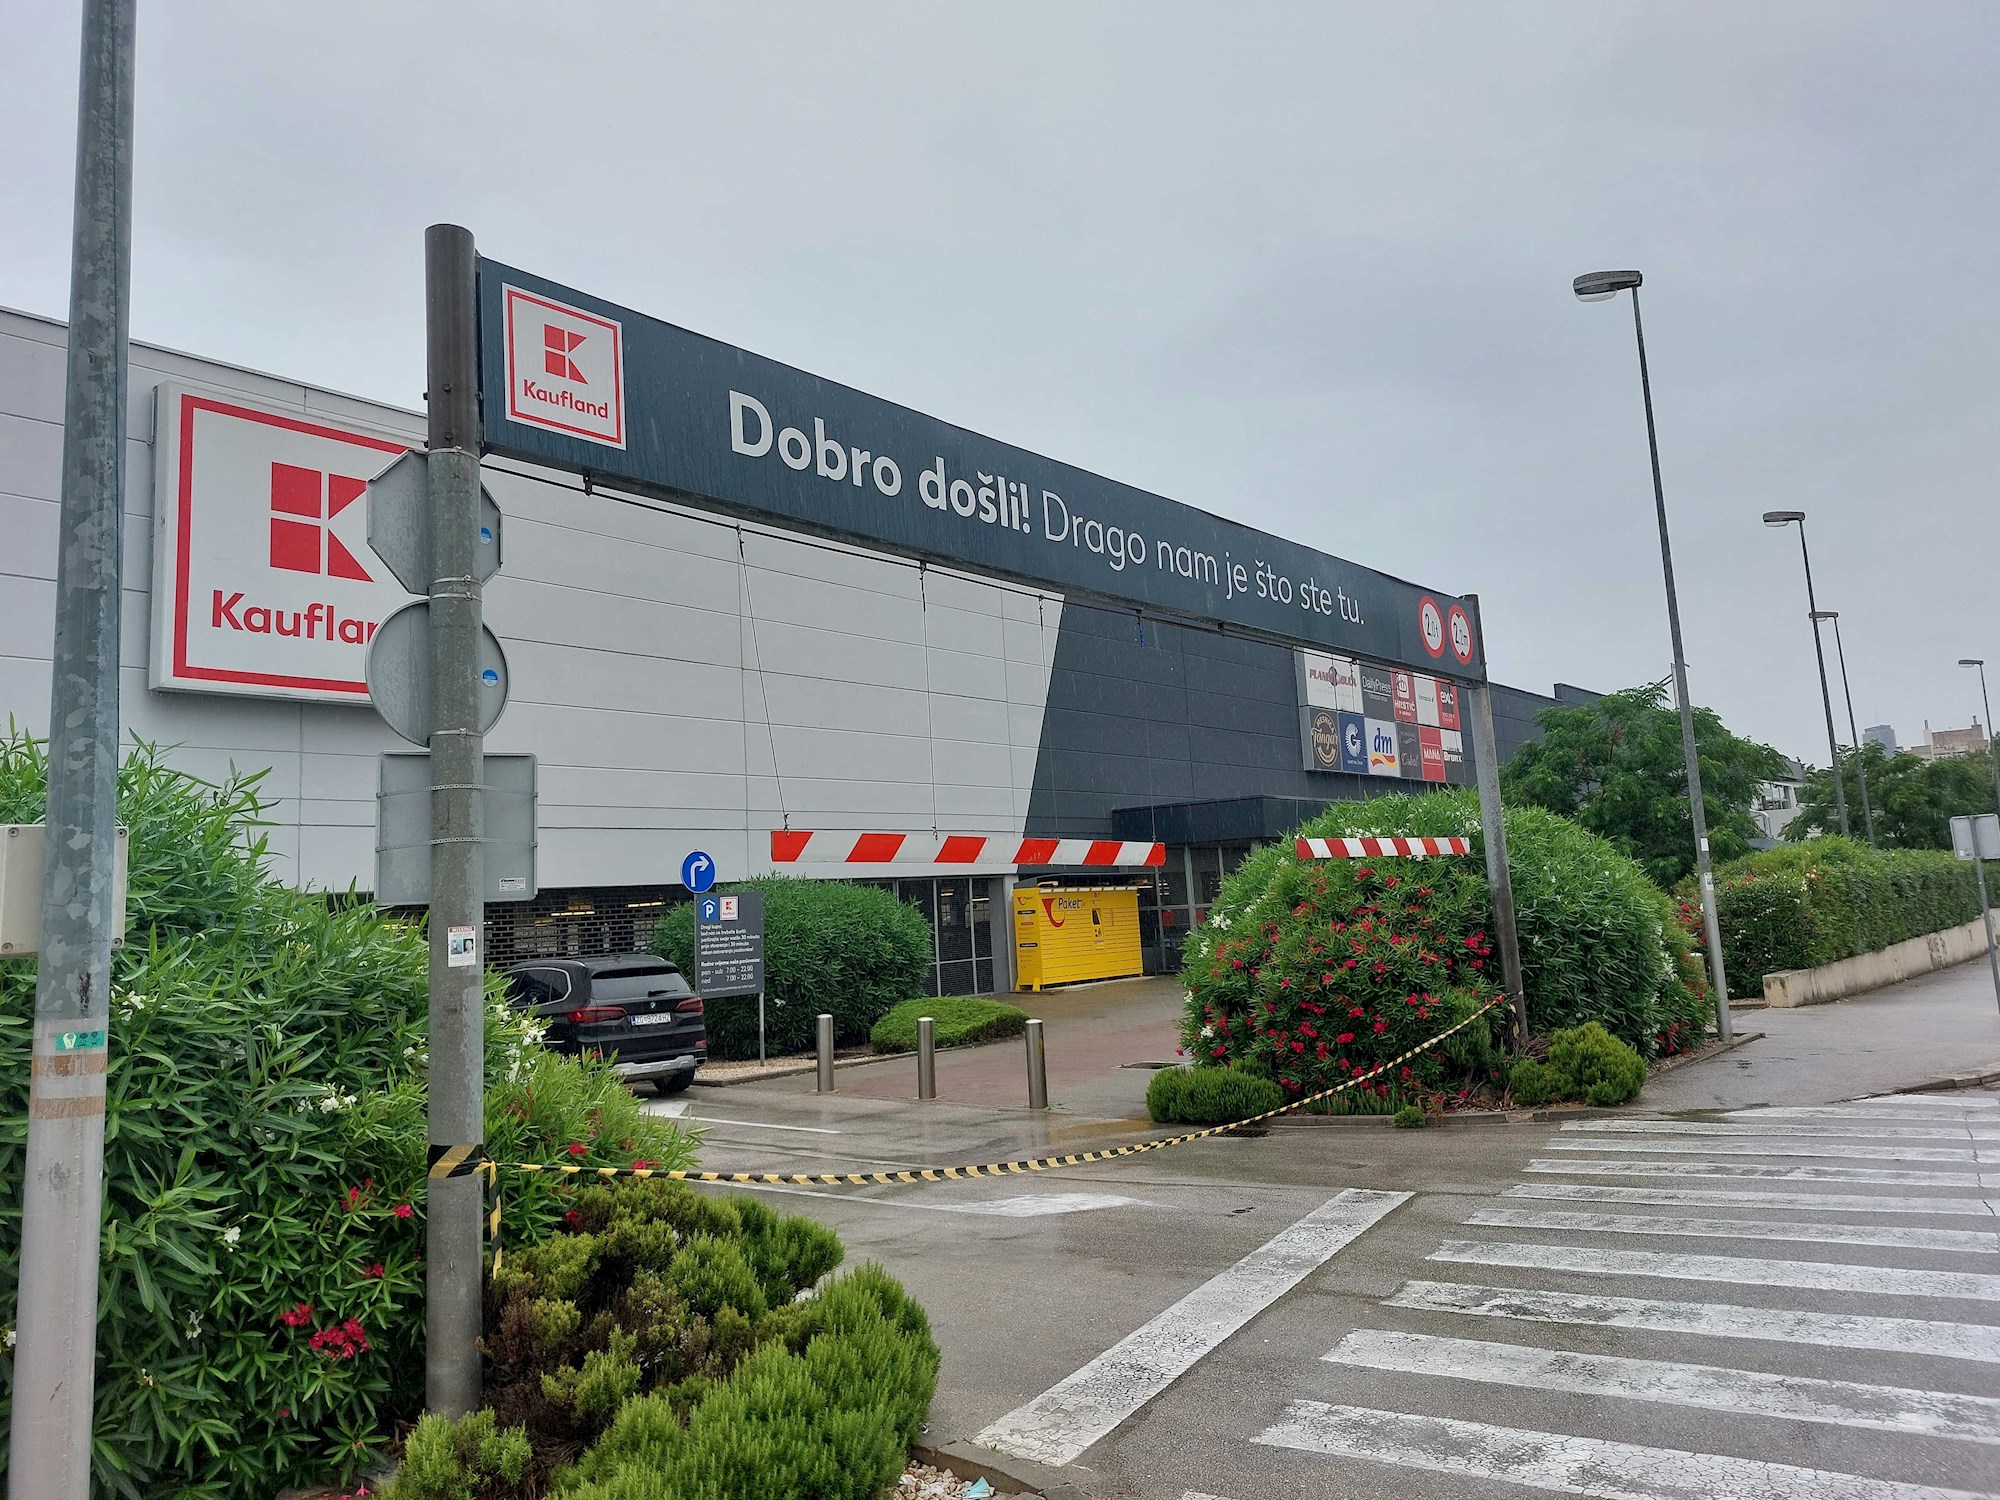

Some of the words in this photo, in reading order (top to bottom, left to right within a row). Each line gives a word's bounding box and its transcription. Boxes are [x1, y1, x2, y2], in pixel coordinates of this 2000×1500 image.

[523, 378, 609, 420] Kaufland
[729, 389, 902, 497] Dobro
[918, 456, 1031, 534] došli!
[1042, 490, 1146, 572] Drago
[1156, 539, 1219, 585] nam
[1225, 551, 1248, 600] je
[1255, 558, 1293, 605] što
[1299, 576, 1332, 616] ste
[1337, 585, 1365, 626] tu.
[212, 589, 379, 644] Kaufla
[1374, 727, 1392, 754] dm
